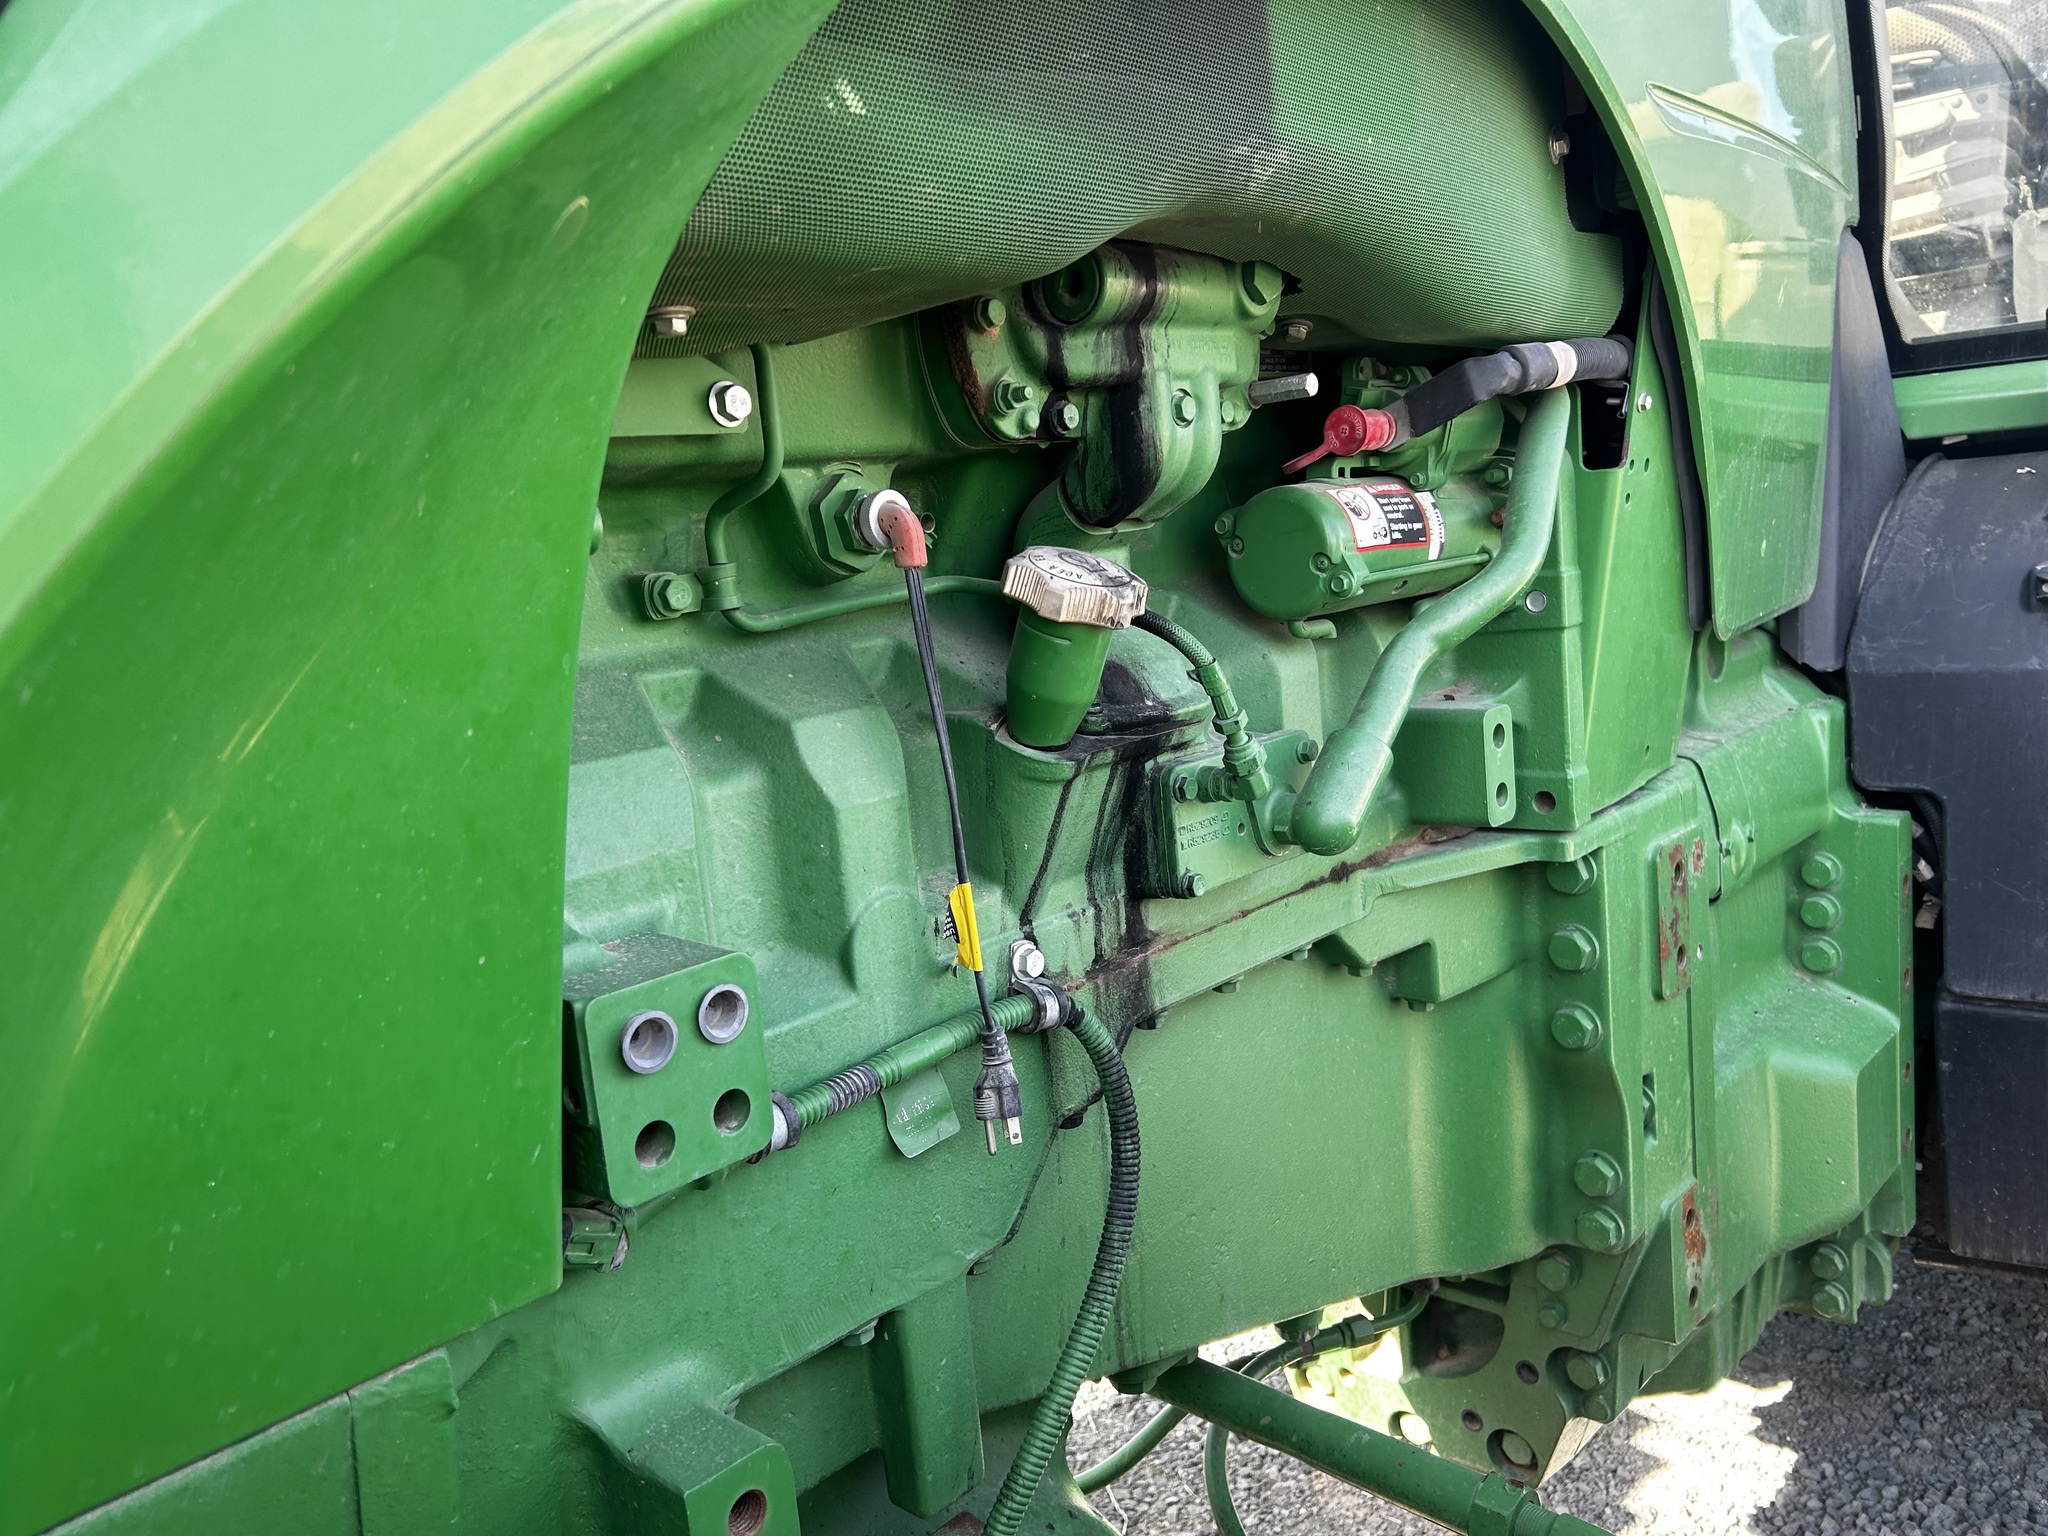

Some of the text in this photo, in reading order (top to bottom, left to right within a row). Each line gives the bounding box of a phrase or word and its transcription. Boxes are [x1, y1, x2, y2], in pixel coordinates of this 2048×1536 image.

[1343, 411, 1363, 439] POSITIVE
[1373, 483, 1404, 491] DANGER
[1397, 504, 1409, 512] park
[1390, 522, 1408, 532] Starting
